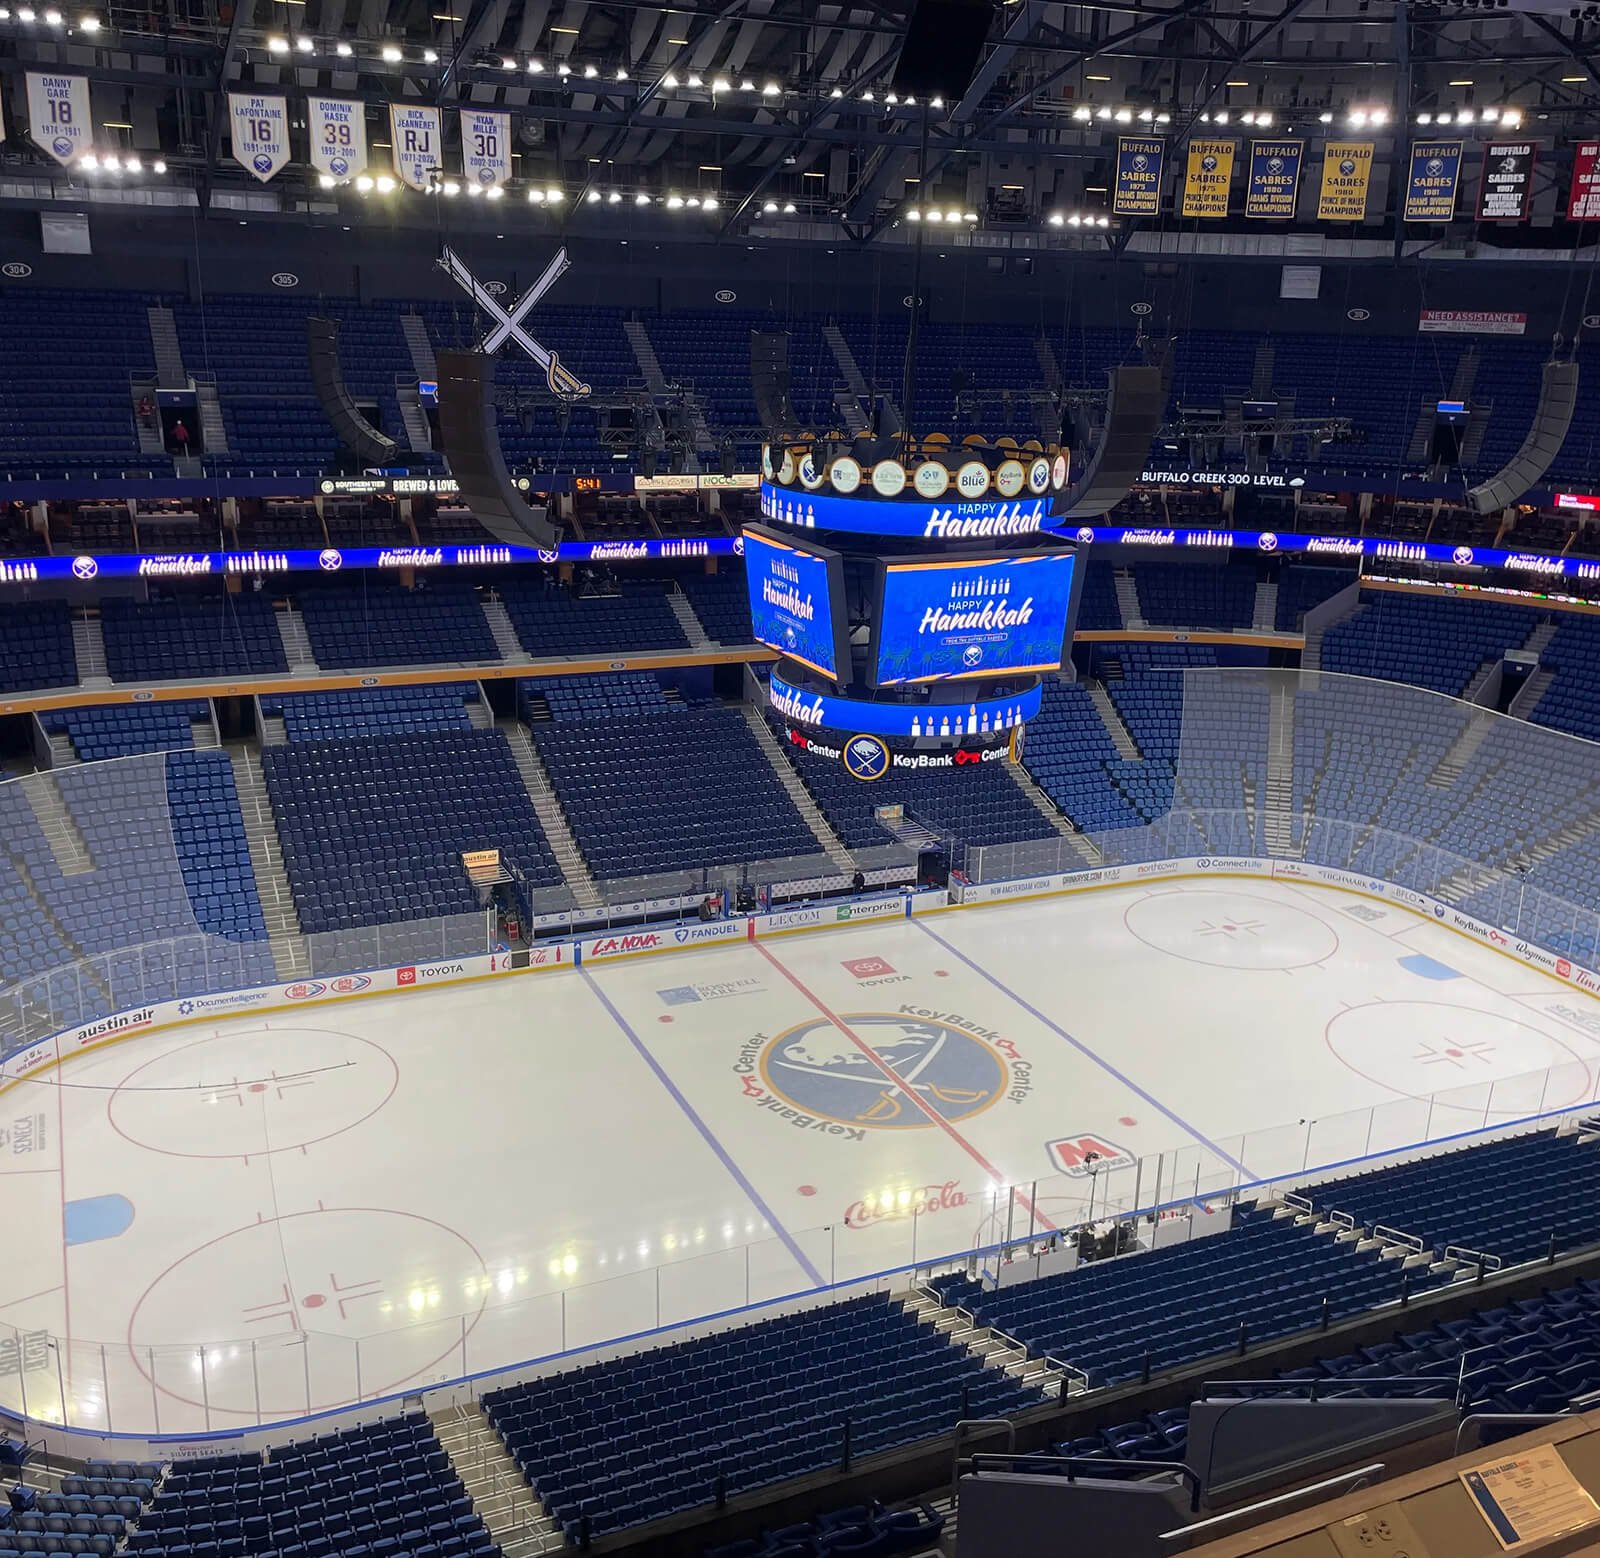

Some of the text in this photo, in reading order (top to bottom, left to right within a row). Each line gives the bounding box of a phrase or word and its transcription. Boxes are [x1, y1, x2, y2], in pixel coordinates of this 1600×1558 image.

[42, 77, 72, 88] DANNY
[47, 88, 70, 98] GARE
[250, 99, 265, 108] PAT
[319, 102, 353, 113] DOMINIK
[48, 99, 72, 123] 18
[235, 107, 282, 119] LAFONTAINE
[324, 112, 349, 122] HASEK
[407, 110, 425, 120] RICK
[397, 119, 435, 130] JEANNERET
[475, 115, 495, 125] RYAN
[248, 119, 271, 142] 16
[325, 123, 351, 145] 39
[472, 124, 498, 134] MILLER
[405, 130, 429, 152] RJ
[474, 135, 497, 157] 30
[1121, 143, 1161, 154] BUFFALO
[1190, 145, 1233, 154] BUFFALO
[1255, 147, 1298, 157] BUFFALO
[1327, 149, 1371, 159] BUFFALO
[1415, 147, 1458, 157] BUFFALO
[1490, 146, 1530, 156] BUFFALO
[1121, 171, 1156, 182] SABRES
[1190, 174, 1228, 184] SABRES
[1254, 175, 1293, 185] SABRES
[1326, 177, 1366, 187] SABRES
[1413, 177, 1452, 187] SABRES
[1488, 174, 1526, 183] SABRES
[1116, 200, 1156, 210] CHAMPIONS
[1185, 203, 1227, 213] CHAMPIONS
[1248, 203, 1292, 213] CHAMPIONS
[1320, 206, 1363, 216] CHAMPIONS
[1407, 207, 1451, 216] CHAMPIONS
[9, 266, 25, 275] 304
[278, 276, 292, 284] 305
[1428, 311, 1520, 323] NEED ASSISTANCE?
[576, 478, 600, 489] 5:41
[961, 475, 985, 488] Blue
[1142, 472, 1286, 487] BUFFALO CREEK 300 LEVEL
[393, 480, 459, 492] BREWED & LOVE
[957, 504, 996, 515] HAPPY
[924, 499, 1042, 537] Hanukkah
[1121, 530, 1175, 545] Hanukkah
[590, 542, 648, 560] Hanukkah
[1307, 538, 1364, 555] Hanukkah
[378, 548, 443, 567] Hanukkah
[139, 555, 211, 577] Hanukkah
[1503, 554, 1565, 574] Hanukkah
[772, 578, 788, 591] HAPPY
[763, 577, 814, 621] Hanukkah
[948, 600, 982, 611] HAPPY
[918, 597, 1034, 634] Hanukkah
[806, 740, 841, 760] Center
[893, 745, 1010, 769] KeyBank Center
[769, 911, 821, 926] LECOM
[691, 925, 739, 938] FANDUEL
[1454, 915, 1489, 937] KeyBank
[592, 939, 619, 955] LA
[620, 934, 661, 949] NOVA
[420, 965, 464, 977] TOYOTA
[857, 976, 912, 988] TOYOTA
[78, 1009, 154, 1041] austin air
[899, 1004, 1032, 1105] KeyBank Center
[733, 1033, 866, 1141] KeyBank Center
[14, 1115, 32, 1154] SENECA
[1055, 1137, 1120, 1168] M
